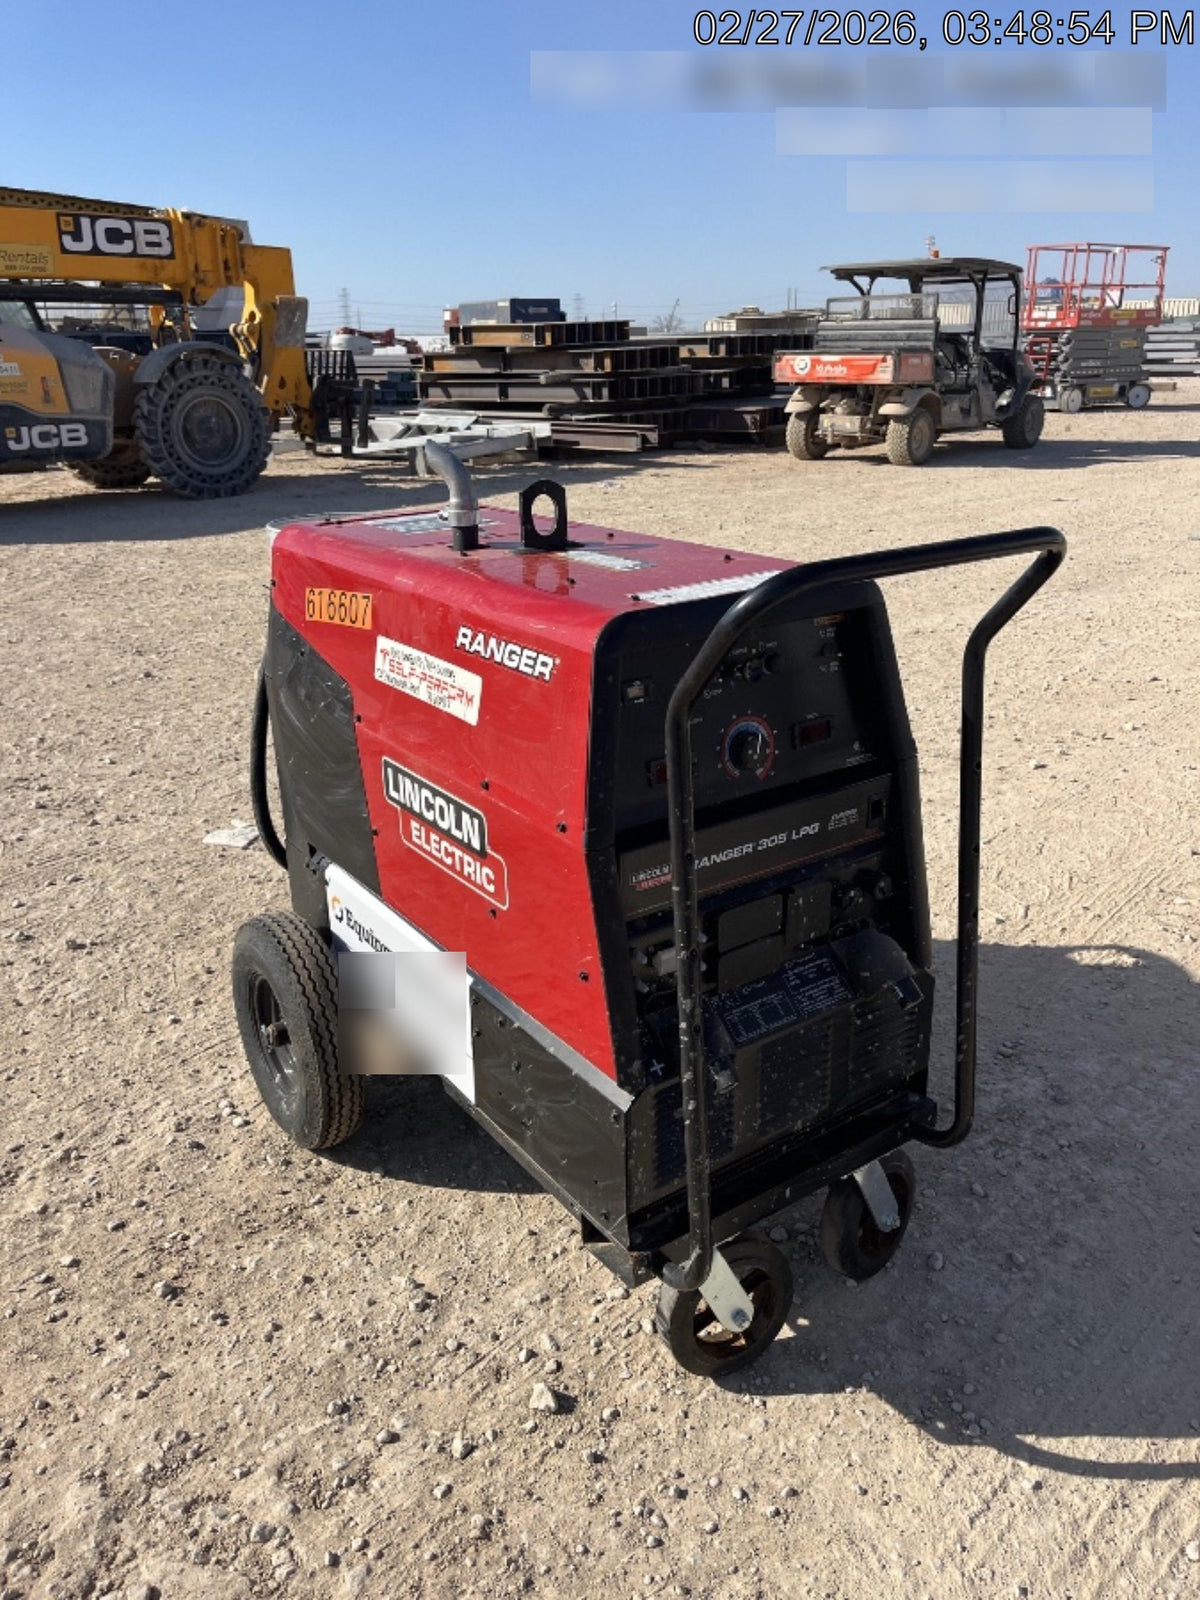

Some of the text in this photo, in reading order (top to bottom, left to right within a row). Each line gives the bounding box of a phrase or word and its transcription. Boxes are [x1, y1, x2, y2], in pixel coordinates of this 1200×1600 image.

[61, 216, 172, 256] JCB
[7, 423, 88, 451] JCB
[306, 588, 371, 627] 616607
[456, 625, 555, 682] RANGER
[386, 767, 481, 851] LINCOLN
[410, 818, 496, 894] ELECTRIC
